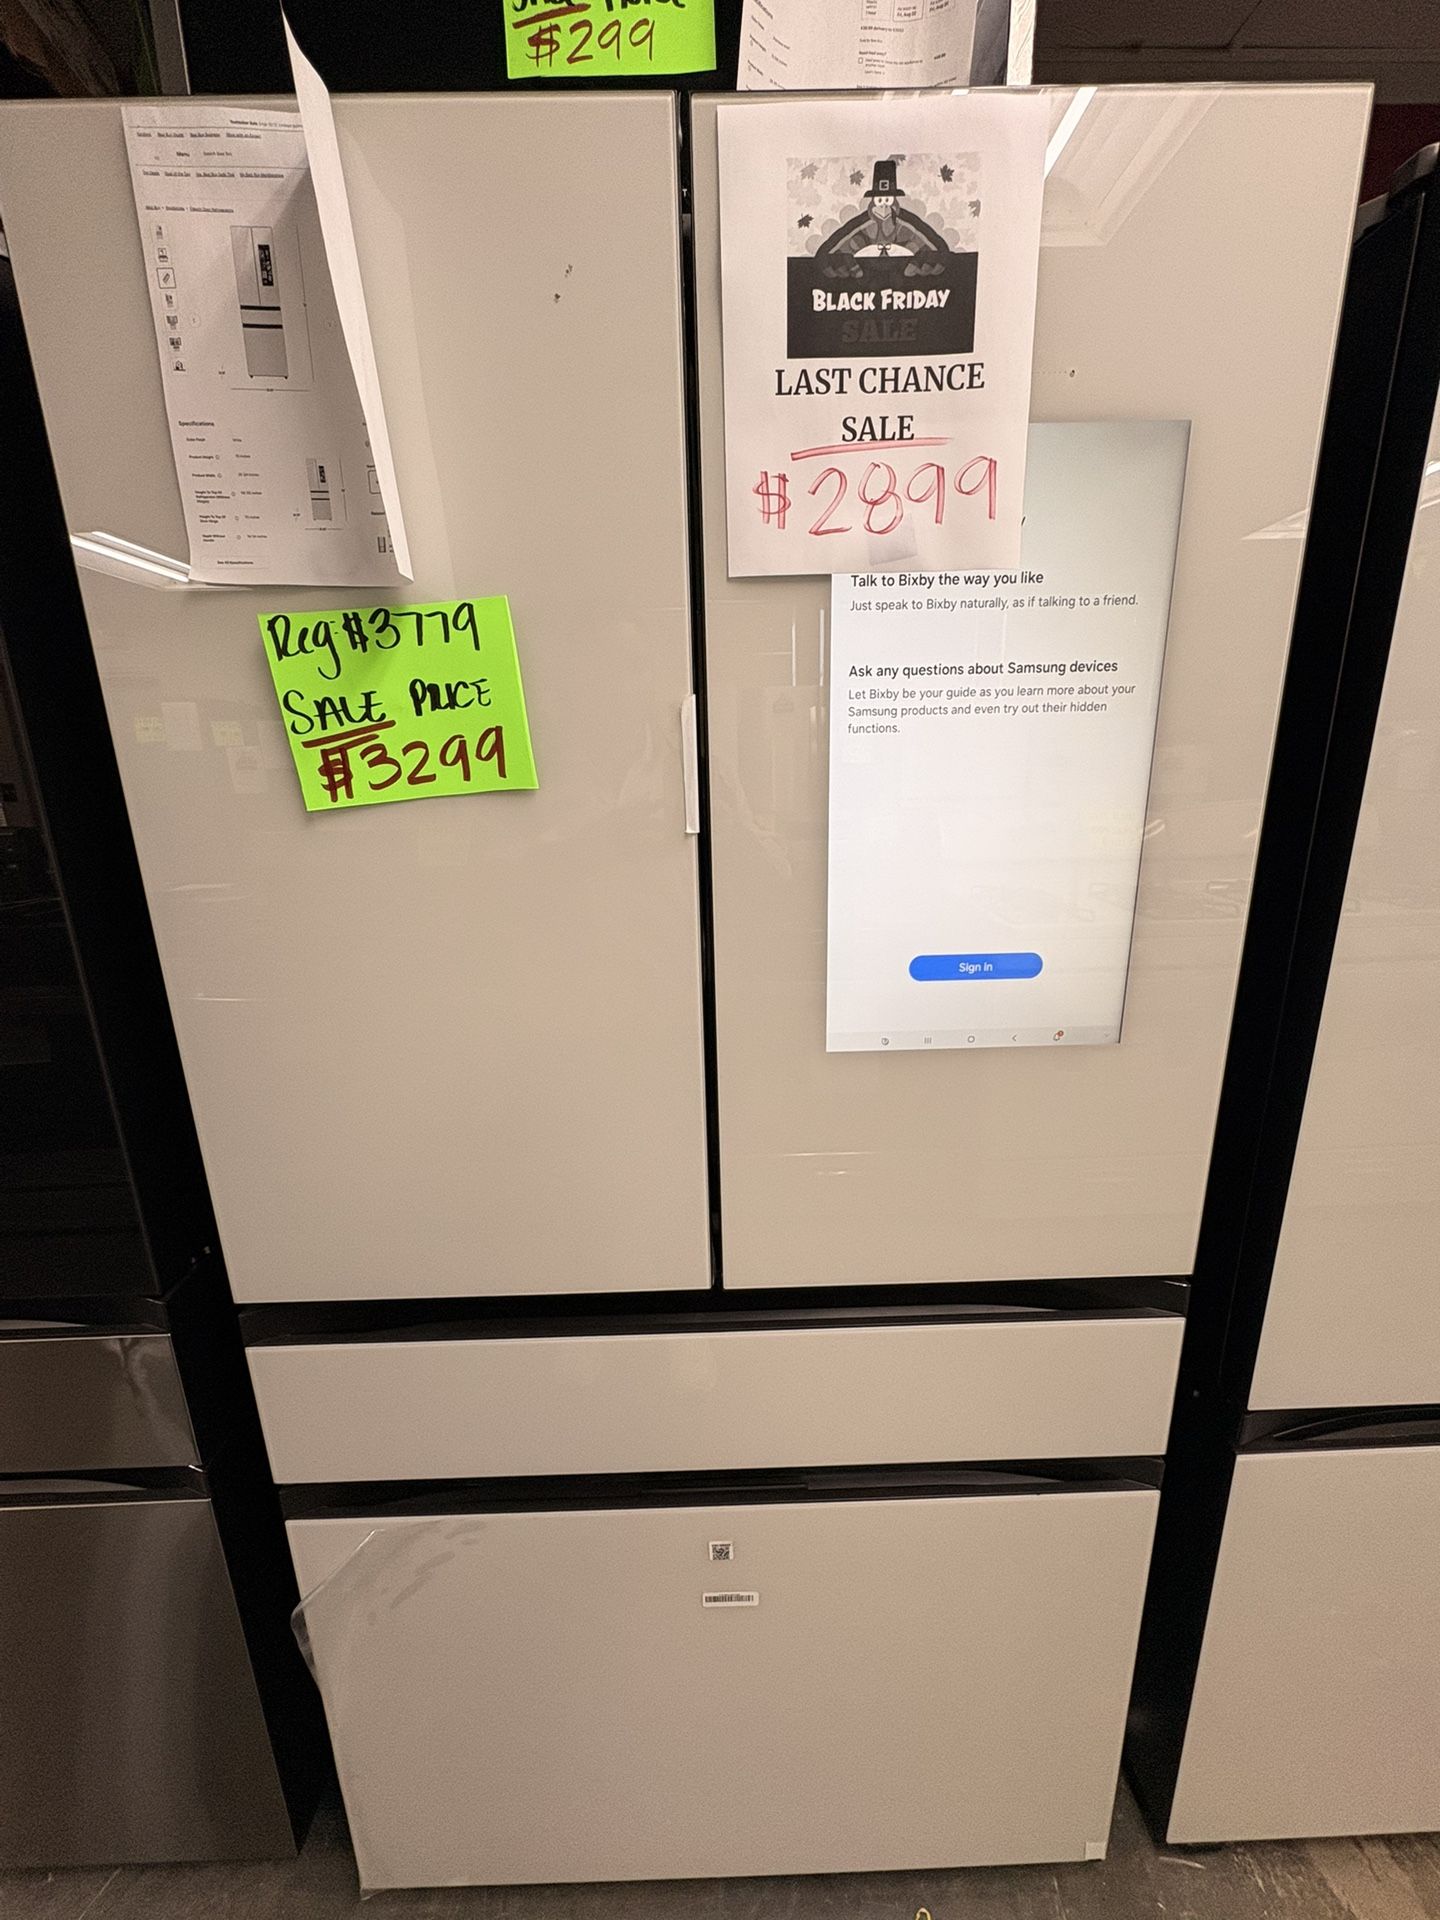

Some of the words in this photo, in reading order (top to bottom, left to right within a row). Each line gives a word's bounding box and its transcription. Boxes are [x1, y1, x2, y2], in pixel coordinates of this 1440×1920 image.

[526, 18, 656, 67] $299
[812, 288, 876, 312] BLACK
[880, 288, 951, 311] FRIDAY
[841, 317, 918, 343] SALE
[775, 368, 852, 396] LAST
[858, 362, 986, 394] CHANCE
[841, 415, 915, 442] SALE
[752, 455, 998, 536] $2899
[851, 574, 877, 587] Talk
[881, 575, 895, 587] to
[898, 573, 935, 589] Bixby
[938, 573, 960, 585] the
[963, 574, 990, 588] way
[993, 574, 1017, 588] you
[1020, 571, 1044, 584] like
[850, 600, 872, 611] Just
[875, 599, 909, 612] speak
[911, 600, 923, 610] to
[926, 598, 957, 612] Bixby
[960, 597, 1009, 611] naturally,
[1012, 599, 1025, 608] as
[1027, 596, 1036, 608] if
[1038, 596, 1076, 609] talking
[1079, 597, 1091, 606] to
[1093, 598, 1100, 606] a
[1103, 594, 1139, 606] friend.
[342, 602, 481, 653] $3779
[848, 665, 873, 677] Ask
[876, 666, 899, 680] any
[902, 663, 965, 679] questions
[967, 663, 1004, 675] about
[1007, 661, 1066, 676] Samsung
[1069, 660, 1119, 673] devices
[848, 689, 867, 700] Let
[869, 688, 900, 701] Bixby
[902, 688, 917, 699] be
[919, 689, 944, 701] your
[946, 687, 977, 700] guide
[979, 688, 992, 697] as
[994, 688, 1015, 699] you
[1016, 686, 1044, 696] learn
[1046, 686, 1075, 695] more
[1077, 684, 1109, 695] about
[1111, 685, 1136, 697] your
[282, 689, 387, 735] SALE
[847, 706, 898, 719] Samsung
[900, 704, 949, 718] products
[951, 704, 972, 715] and
[974, 705, 1001, 714] even
[1003, 703, 1019, 716] try
[1021, 703, 1040, 713] out
[1042, 702, 1068, 713] their
[1069, 701, 1108, 712] hidden
[847, 722, 901, 735] functions.
[317, 725, 508, 803] $3299
[958, 962, 982, 974] Sign
[983, 962, 994, 972] in
